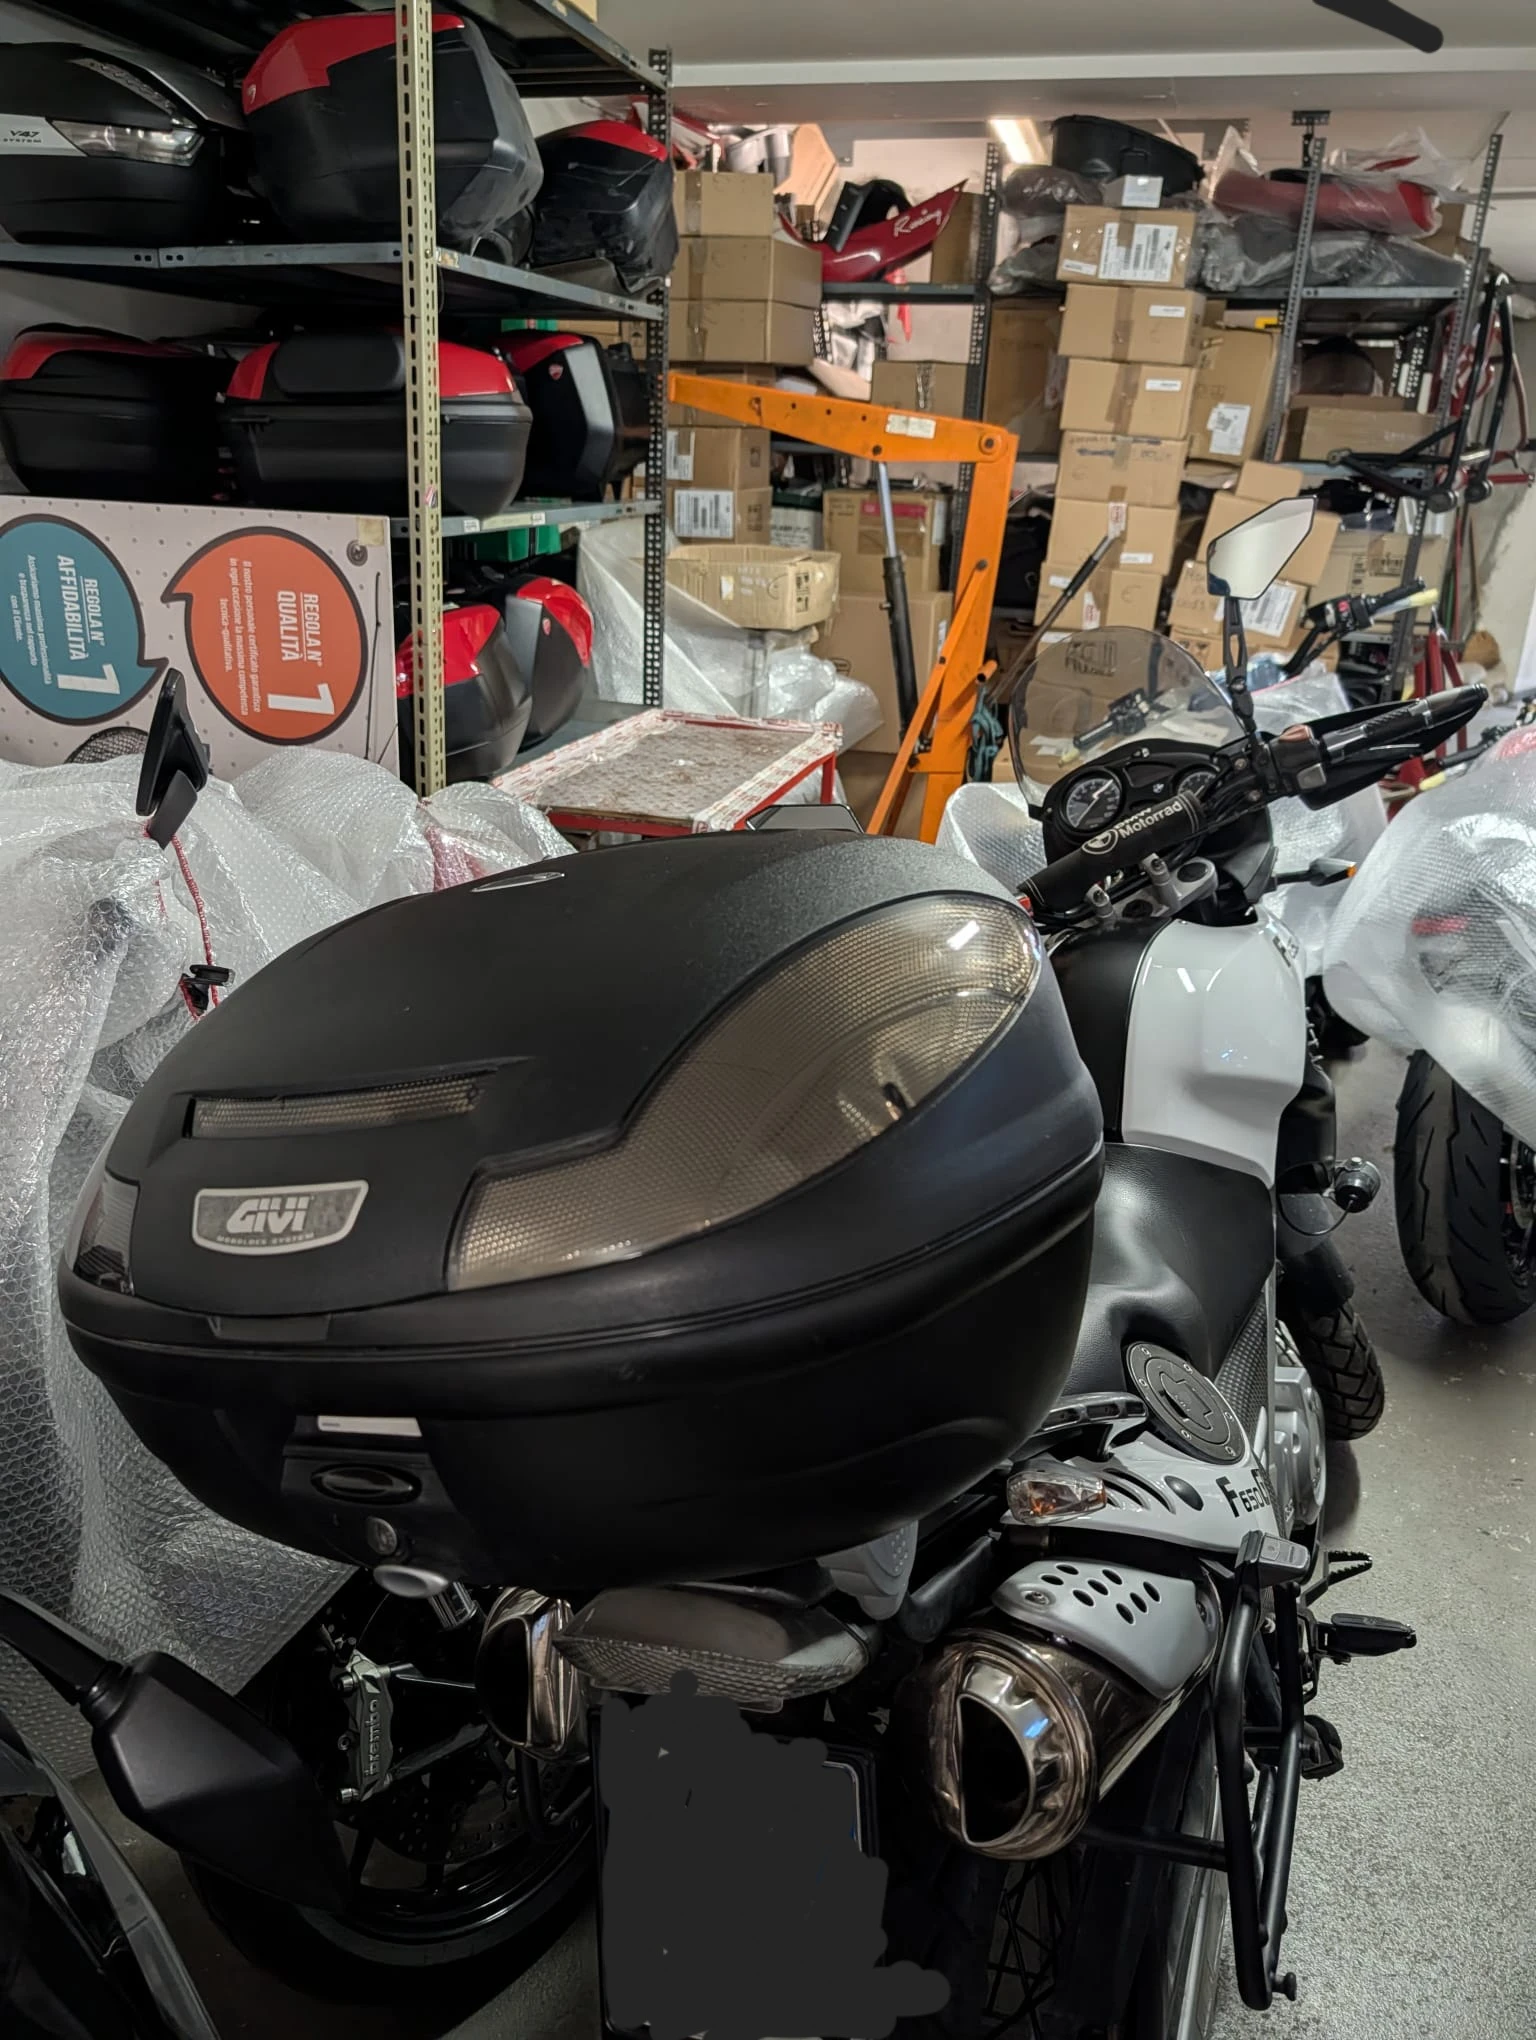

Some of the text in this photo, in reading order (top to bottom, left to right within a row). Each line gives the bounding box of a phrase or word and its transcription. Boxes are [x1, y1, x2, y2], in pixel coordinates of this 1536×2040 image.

[10, 130, 40, 138] V47
[893, 208, 942, 237] Racing
[229, 568, 239, 585] ogni
[230, 558, 239, 566] in
[243, 568, 253, 593] nostro
[19, 579, 31, 621] trasparenza
[57, 555, 88, 660] AFFIDABILITÀ
[84, 579, 101, 627] REGOLA
[232, 587, 244, 624] occasione
[245, 595, 258, 633] personale
[13, 616, 23, 642] Cliente.
[25, 623, 33, 633] nel
[27, 555, 52, 685] Assicuriamo massima professionalità
[278, 591, 303, 661] QUALITÀ
[304, 594, 320, 646] REGOLA
[26, 635, 38, 665] rapporto
[235, 635, 247, 668] massima
[248, 635, 260, 673] certificato
[57, 664, 120, 694] 1
[237, 670, 249, 715] competenza
[249, 675, 261, 712] garantisce
[268, 683, 335, 715] 1
[1119, 801, 1183, 838] Motorrad
[226, 1196, 310, 1234] GIVI
[365, 1699, 381, 1776] brembo
